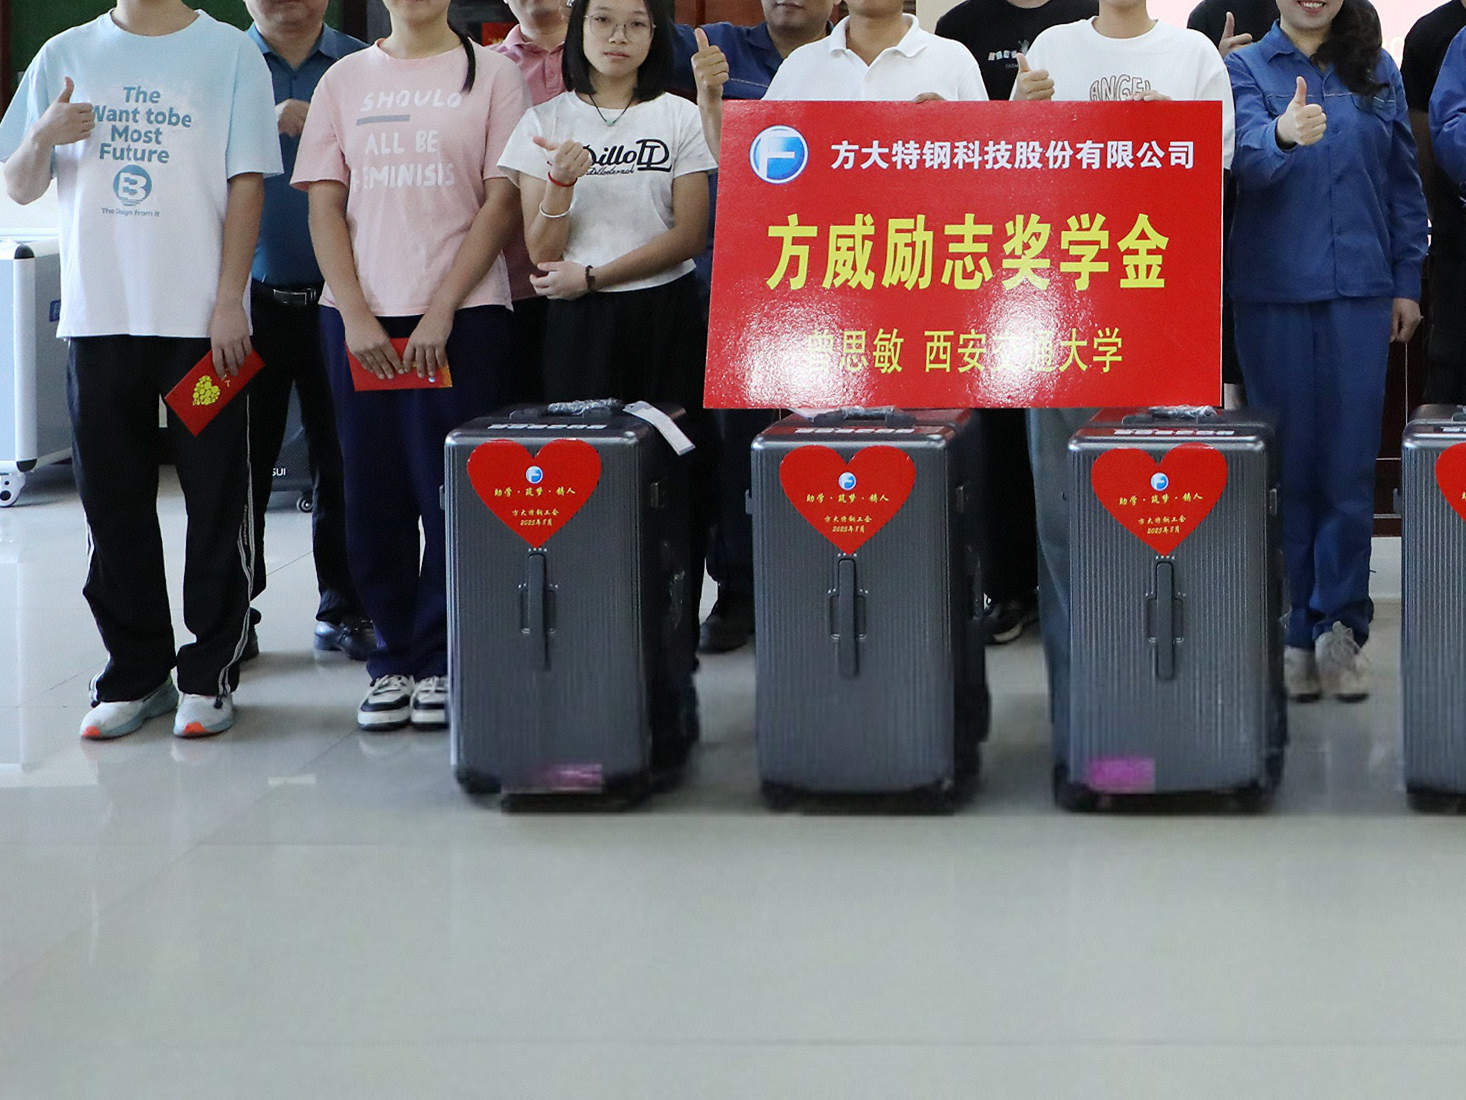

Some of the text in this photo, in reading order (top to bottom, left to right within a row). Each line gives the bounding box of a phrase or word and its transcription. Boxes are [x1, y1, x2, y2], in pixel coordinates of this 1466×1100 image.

[123, 86, 161, 104] The
[111, 125, 162, 145] Most
[365, 130, 439, 155] ALL BE
[99, 143, 170, 164] Future
[830, 140, 1196, 171] 方大特钢科技股份有限公司
[766, 213, 1169, 291] 方威励志奖学金
